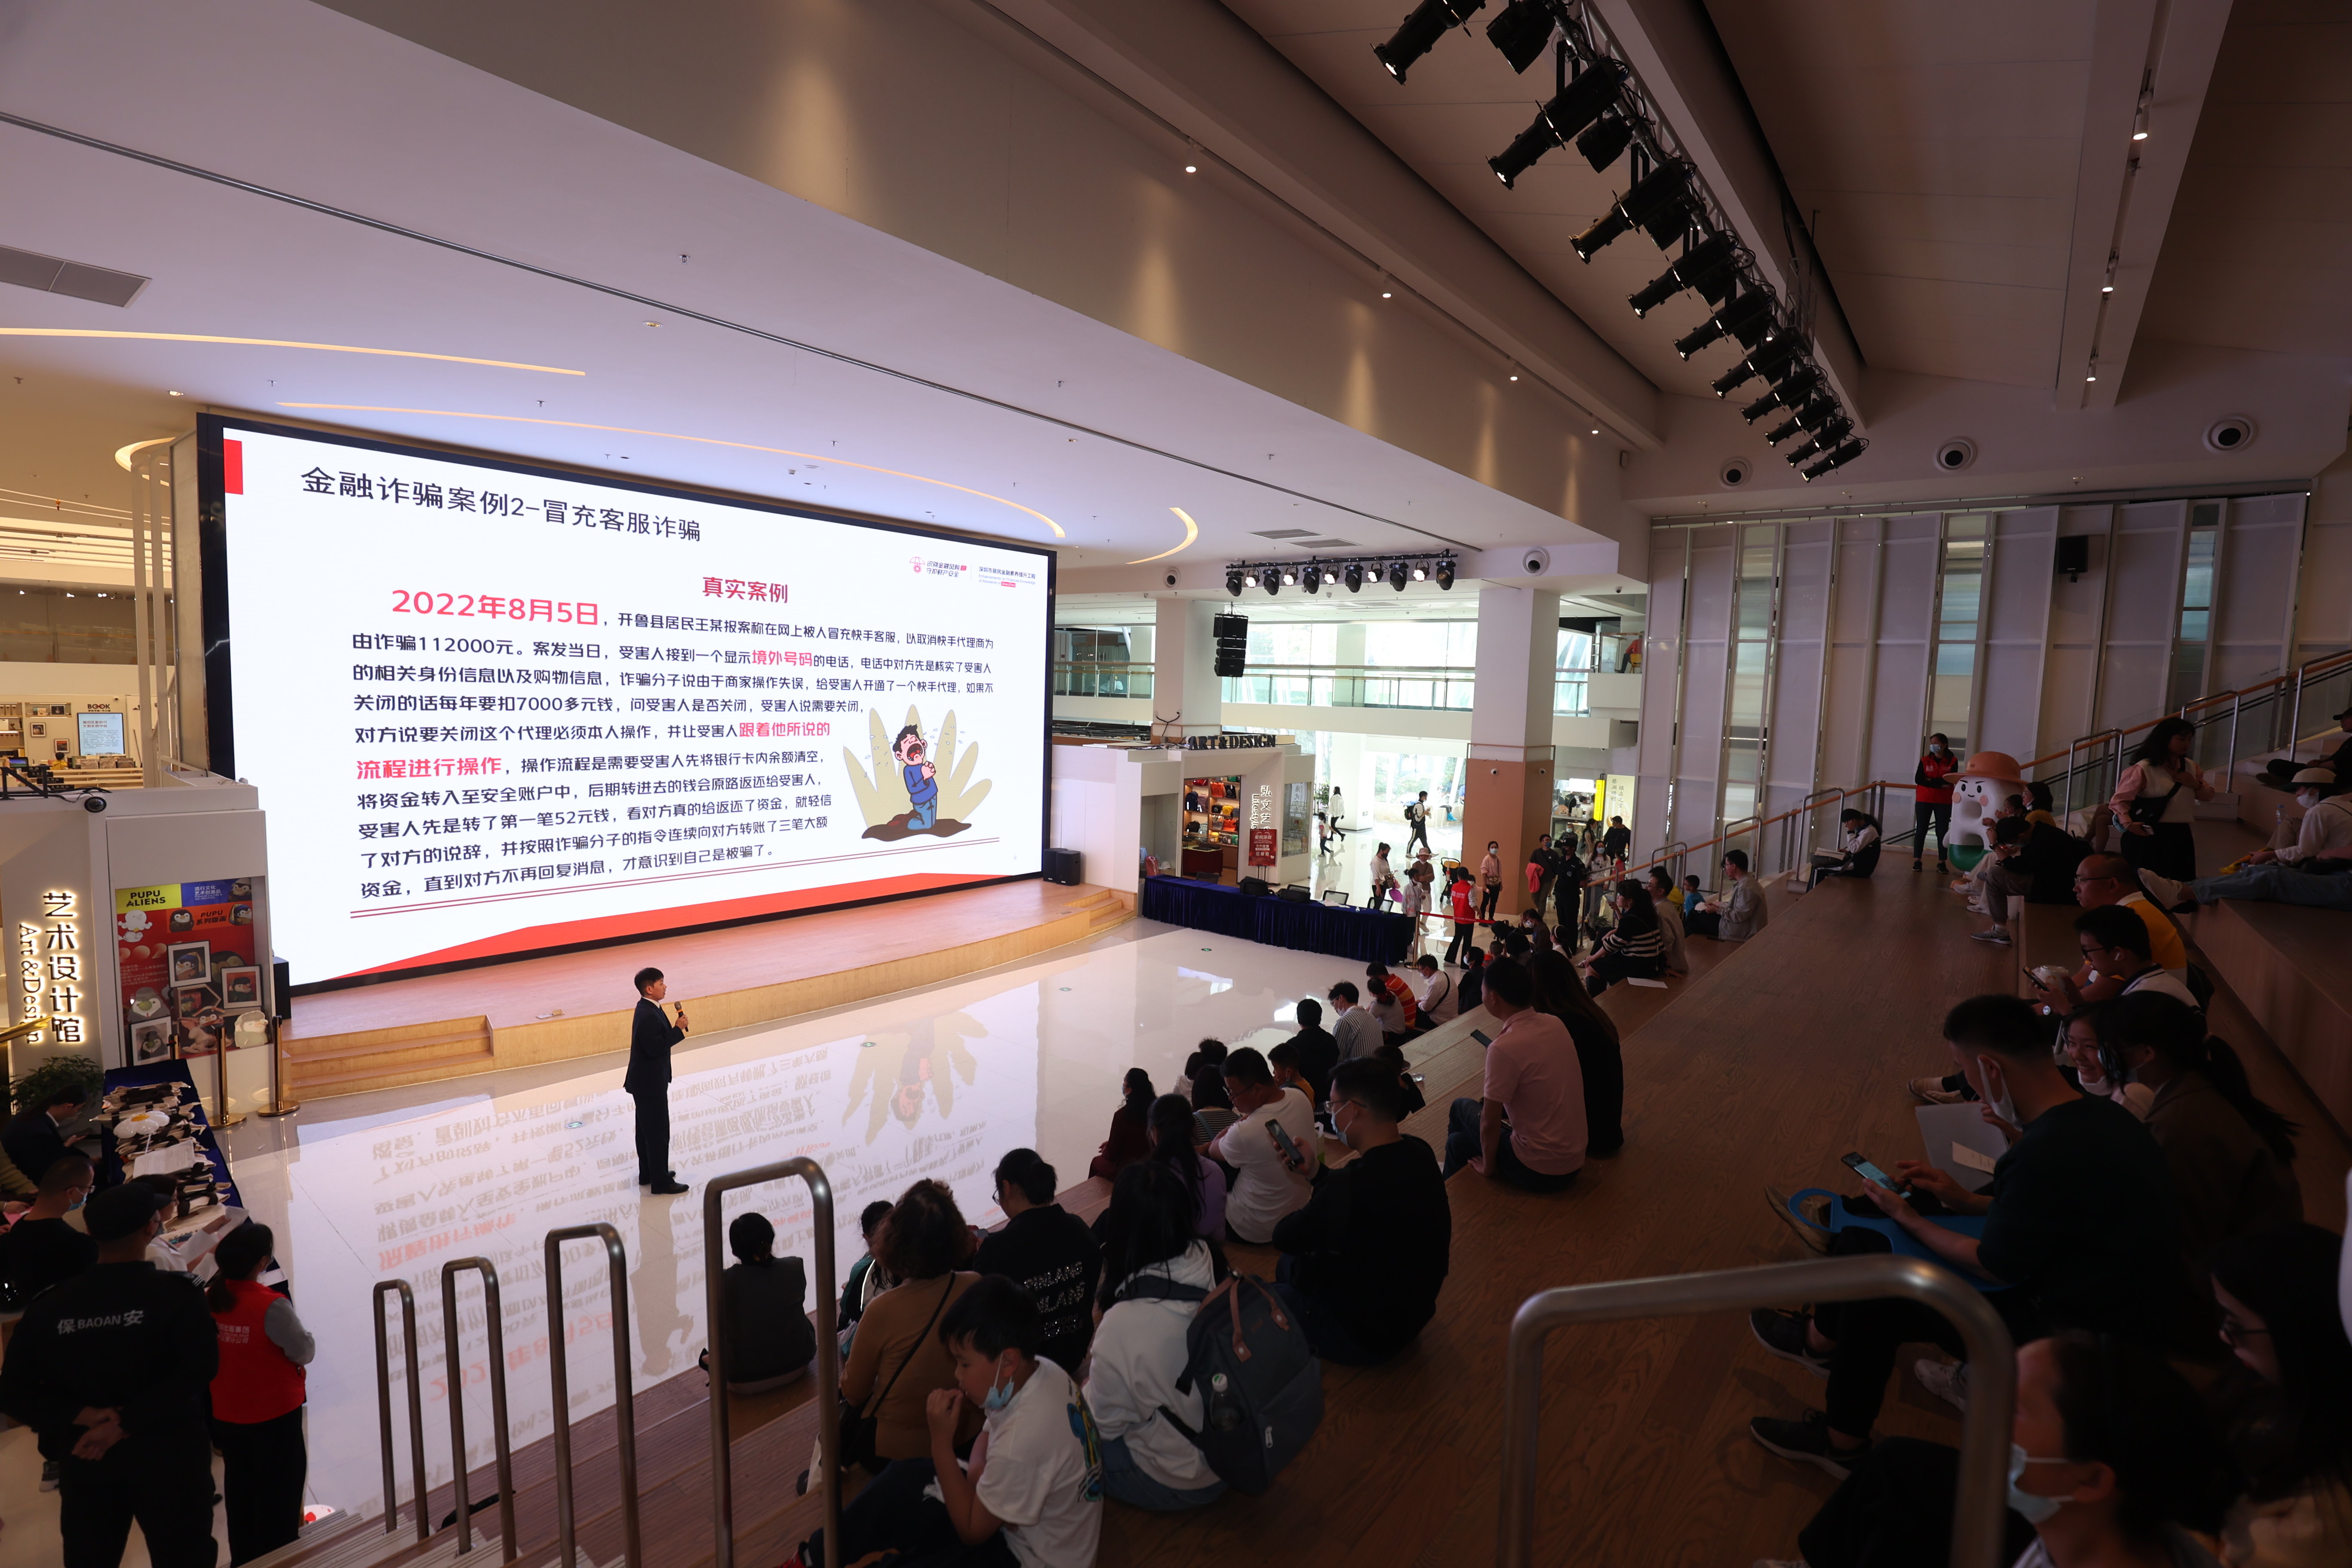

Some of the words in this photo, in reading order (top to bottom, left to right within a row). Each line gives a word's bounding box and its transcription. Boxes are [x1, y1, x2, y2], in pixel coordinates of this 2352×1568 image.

[301, 466, 701, 542] 金融诈骗案例2-冒充客服诈骗
[702, 576, 788, 603] 真实案例
[1250, 794, 1259, 830] Lifestyle
[1261, 786, 1271, 830] 弘文艺
[126, 897, 166, 907] ALIENS
[130, 890, 161, 899] PUPU
[196, 916, 227, 926] 系列版画
[201, 910, 223, 918] PUPU
[43, 892, 80, 1042] 艺术设计馆
[57, 1318, 76, 1335] 保
[77, 1314, 121, 1329] BAOAN
[123, 1310, 144, 1327] 安
